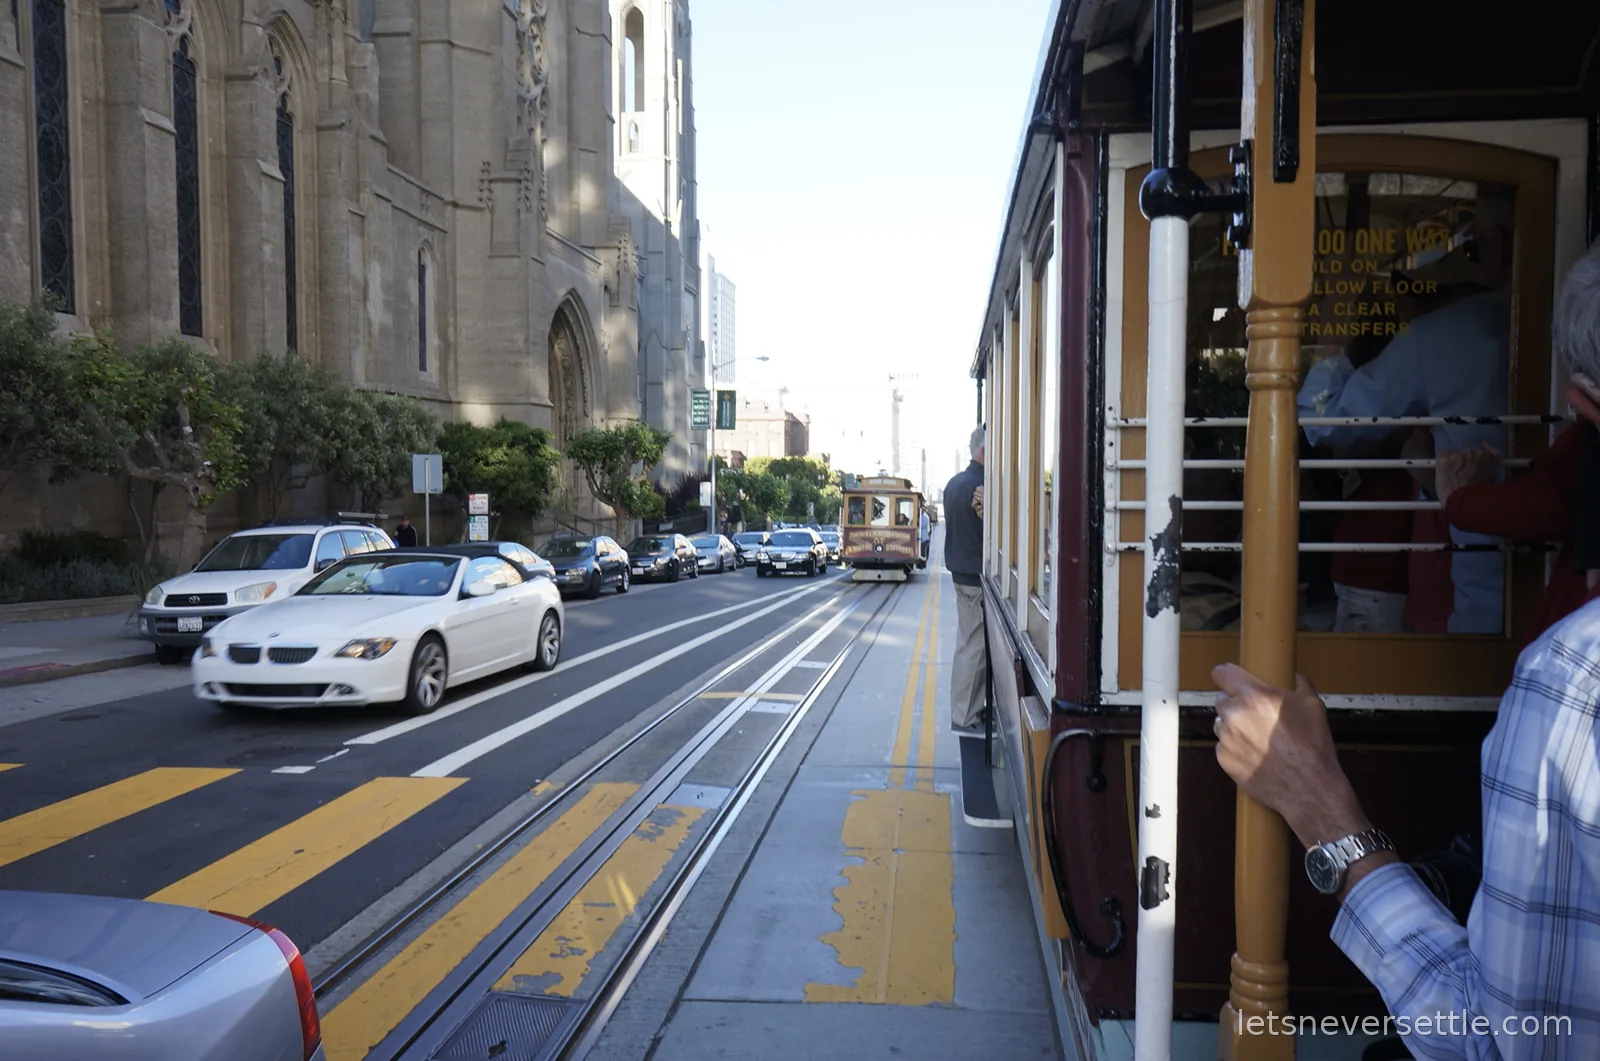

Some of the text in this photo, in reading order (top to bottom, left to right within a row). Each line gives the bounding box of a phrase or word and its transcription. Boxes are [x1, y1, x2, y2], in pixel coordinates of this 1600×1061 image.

[1355, 228, 1396, 254] ONE
[1405, 228, 1450, 253] WAY
[1351, 260, 1378, 273] ON
[1372, 280, 1438, 295] FLOOR
[1334, 302, 1396, 317] CLEAR
[1301, 322, 1409, 337] TRANSFERS
